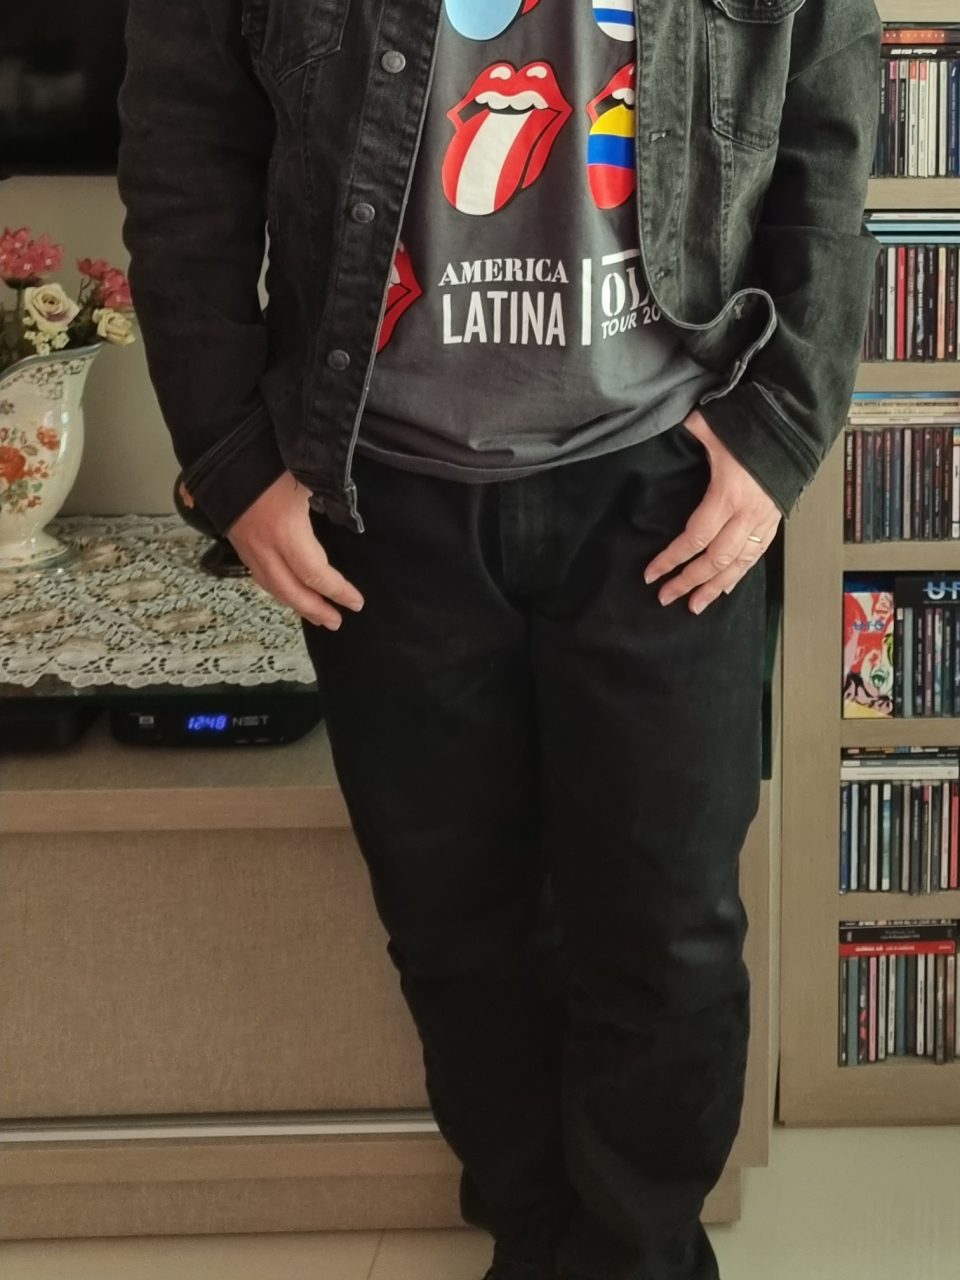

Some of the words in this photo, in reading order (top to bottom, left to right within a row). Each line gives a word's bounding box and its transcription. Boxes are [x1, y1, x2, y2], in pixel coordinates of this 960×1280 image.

[438, 258, 569, 287] AMERICA
[442, 290, 566, 346] LATINA
[601, 312, 637, 340] TOUR
